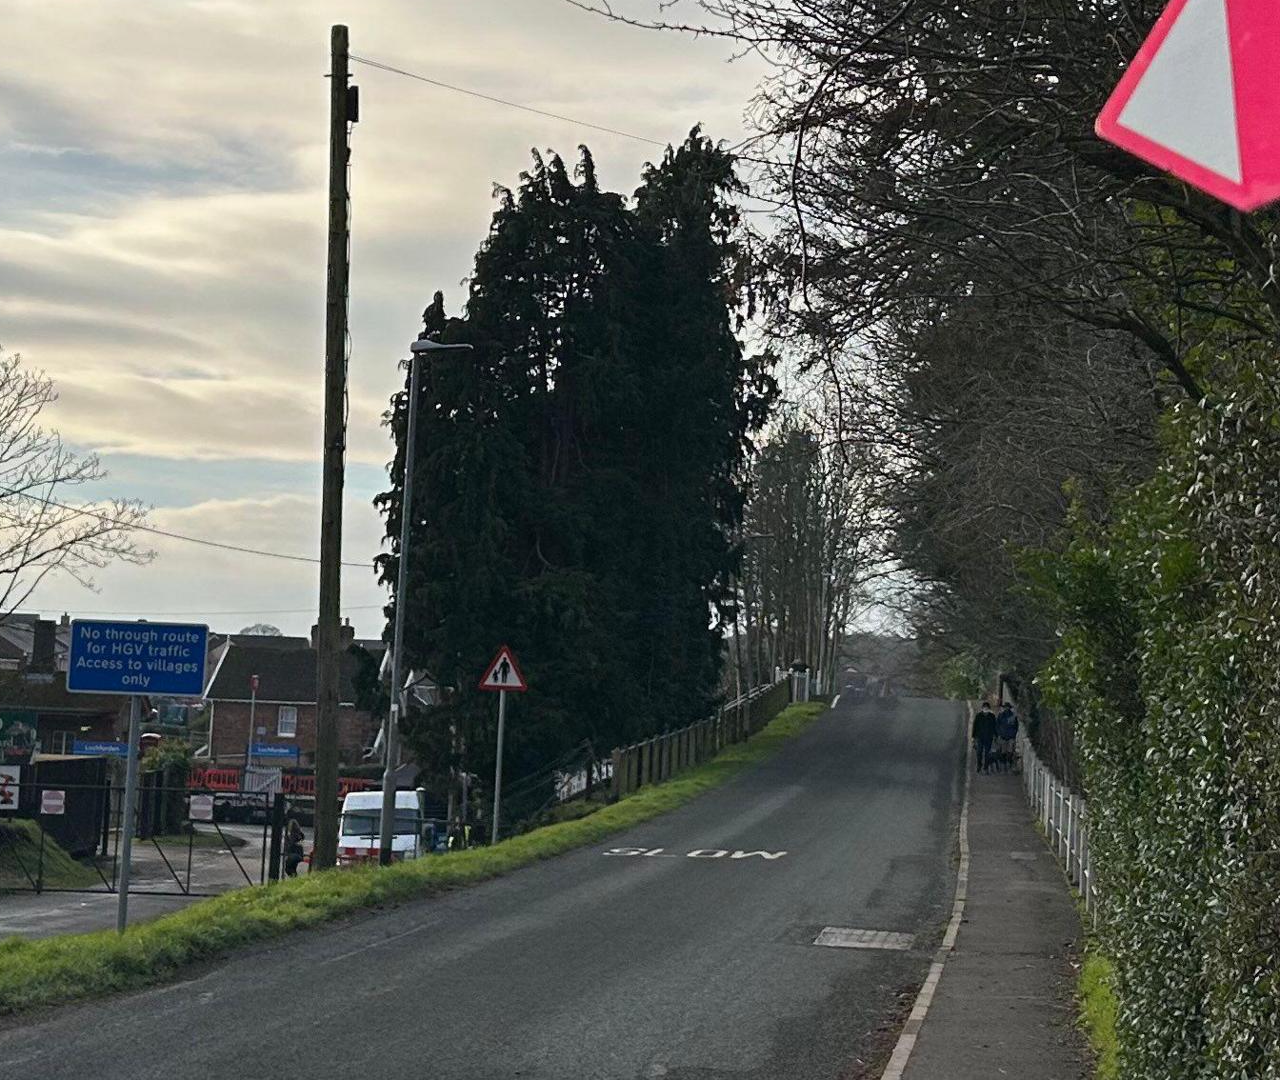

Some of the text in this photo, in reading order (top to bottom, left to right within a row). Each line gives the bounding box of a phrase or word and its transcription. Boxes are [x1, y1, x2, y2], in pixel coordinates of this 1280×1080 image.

[80, 627, 200, 643] No through route
[87, 642, 191, 657] for HGV traffic
[76, 656, 198, 674] Access to villages
[122, 674, 150, 687] only
[603, 847, 788, 859] SLOW
